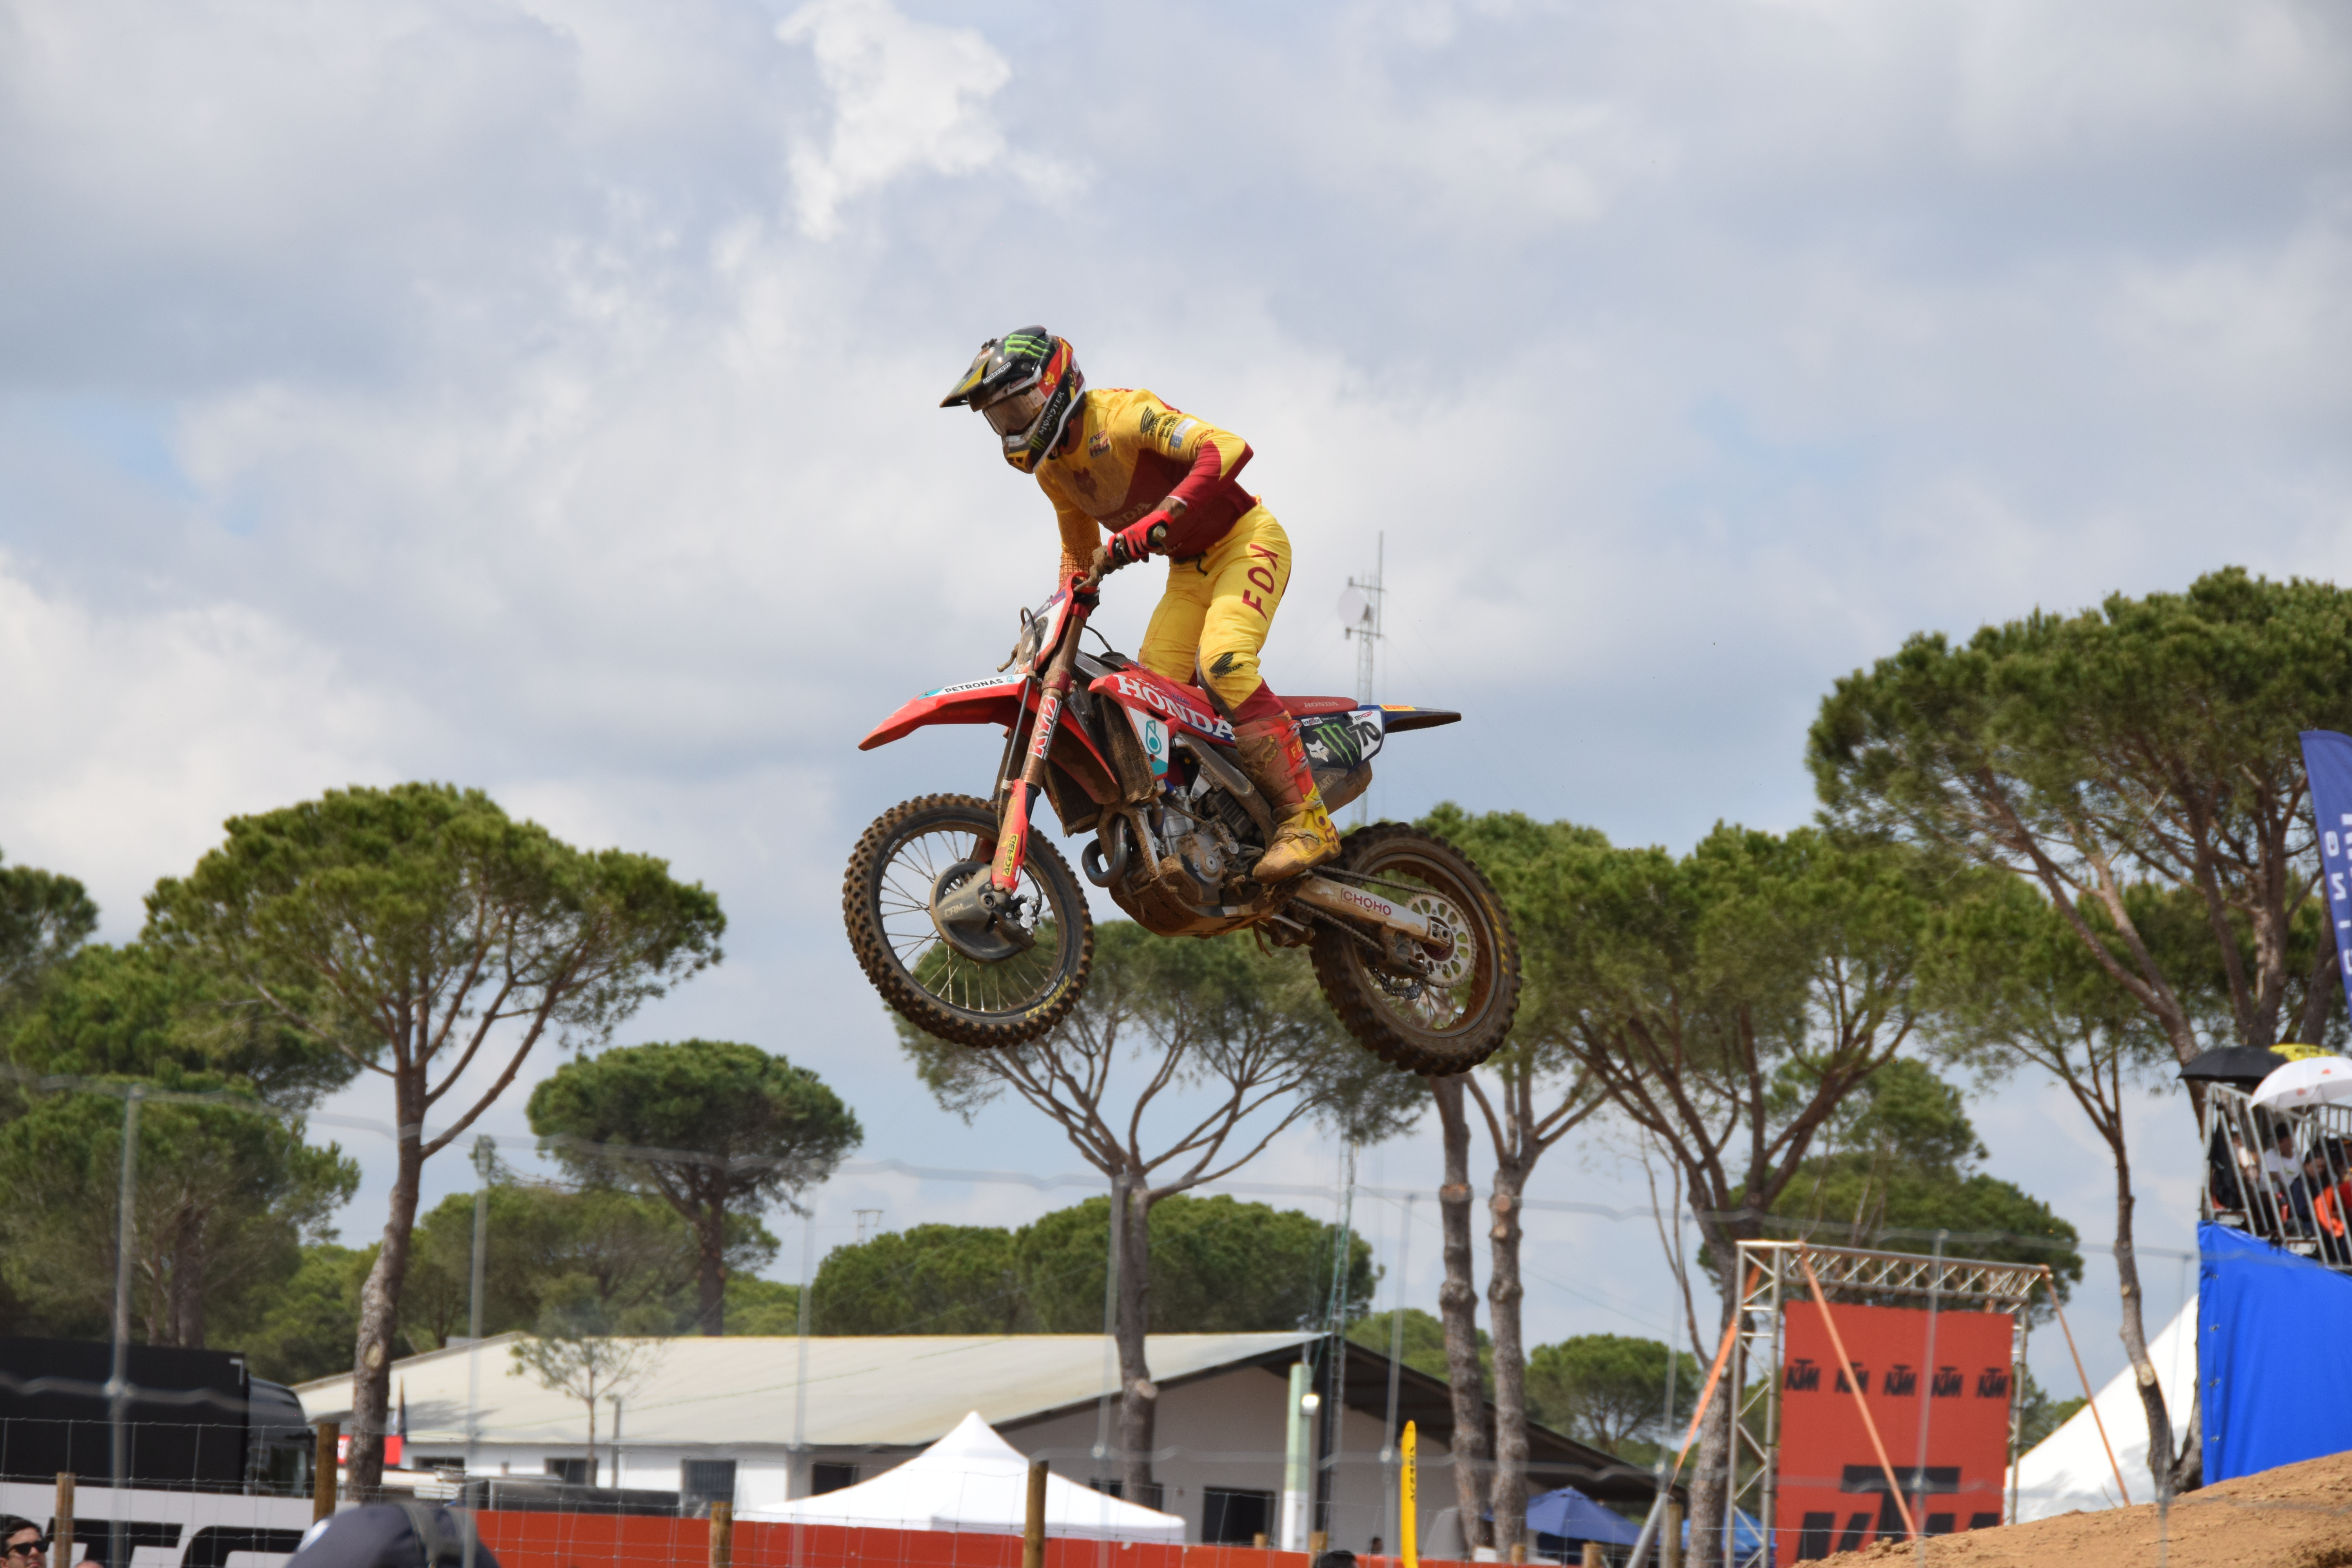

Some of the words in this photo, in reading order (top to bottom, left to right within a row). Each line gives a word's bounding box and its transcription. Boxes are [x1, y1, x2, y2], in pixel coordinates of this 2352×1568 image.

[983, 362, 1011, 383] apdesigns
[1039, 391, 1064, 434] MONSTER
[1242, 543, 1279, 622] FOX
[944, 679, 1003, 693] PETRONAS
[1113, 675, 1235, 740] HONDA
[1291, 737, 1303, 759] FO
[1346, 721, 1381, 747] 70
[1004, 835, 1017, 876] ACERBIS
[1343, 891, 1391, 916] CHOHO
[1025, 975, 1070, 1018] PIRELLI
[1785, 1358, 1820, 1391] KTM
[1884, 1365, 1916, 1396] KTM
[1931, 1367, 1963, 1398] KTM
[1976, 1367, 2008, 1398] KTM
